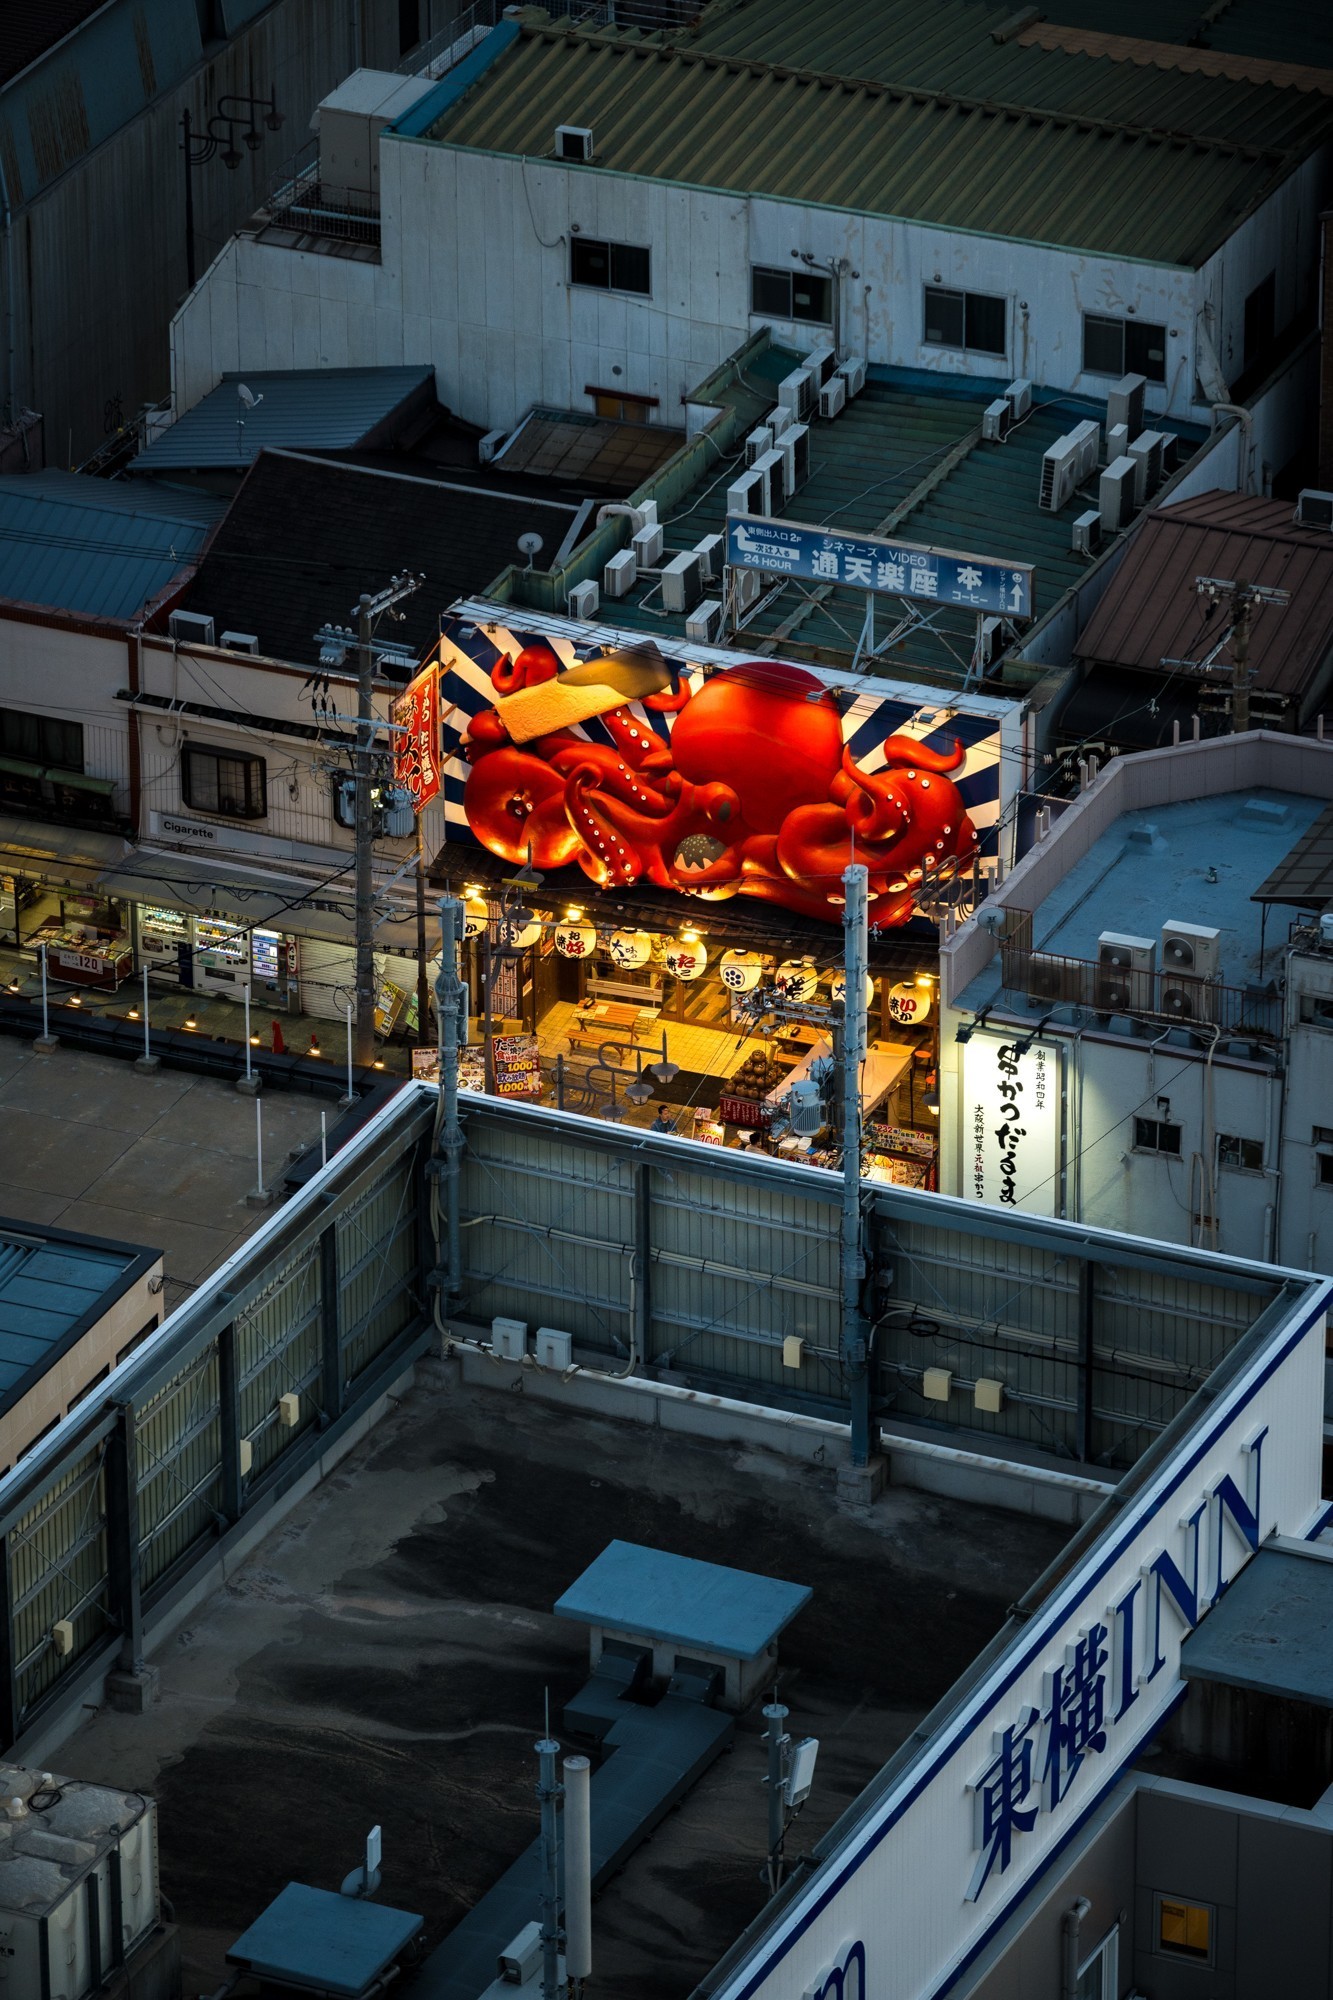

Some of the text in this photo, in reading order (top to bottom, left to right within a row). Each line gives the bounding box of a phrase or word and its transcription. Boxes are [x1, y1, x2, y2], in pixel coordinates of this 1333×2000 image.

[747, 526, 802, 543] 東側出入口 2F
[743, 553, 792, 570] 24 HOUR
[822, 539, 927, 567] シネマーズ VIDEO
[811, 549, 938, 598] 通天楽座
[956, 566, 983, 591] 本
[951, 590, 989, 604] コーヒー
[163, 821, 214, 839] Cigarette
[78, 955, 98, 970] 120
[1034, 1049, 1046, 1111] 創業昭和四年
[994, 1044, 1027, 1206] 串かつだるま
[973, 1103, 985, 1199] 大阪新世界元祖串かつ
[967, 1425, 1269, 1902] 東横INN
